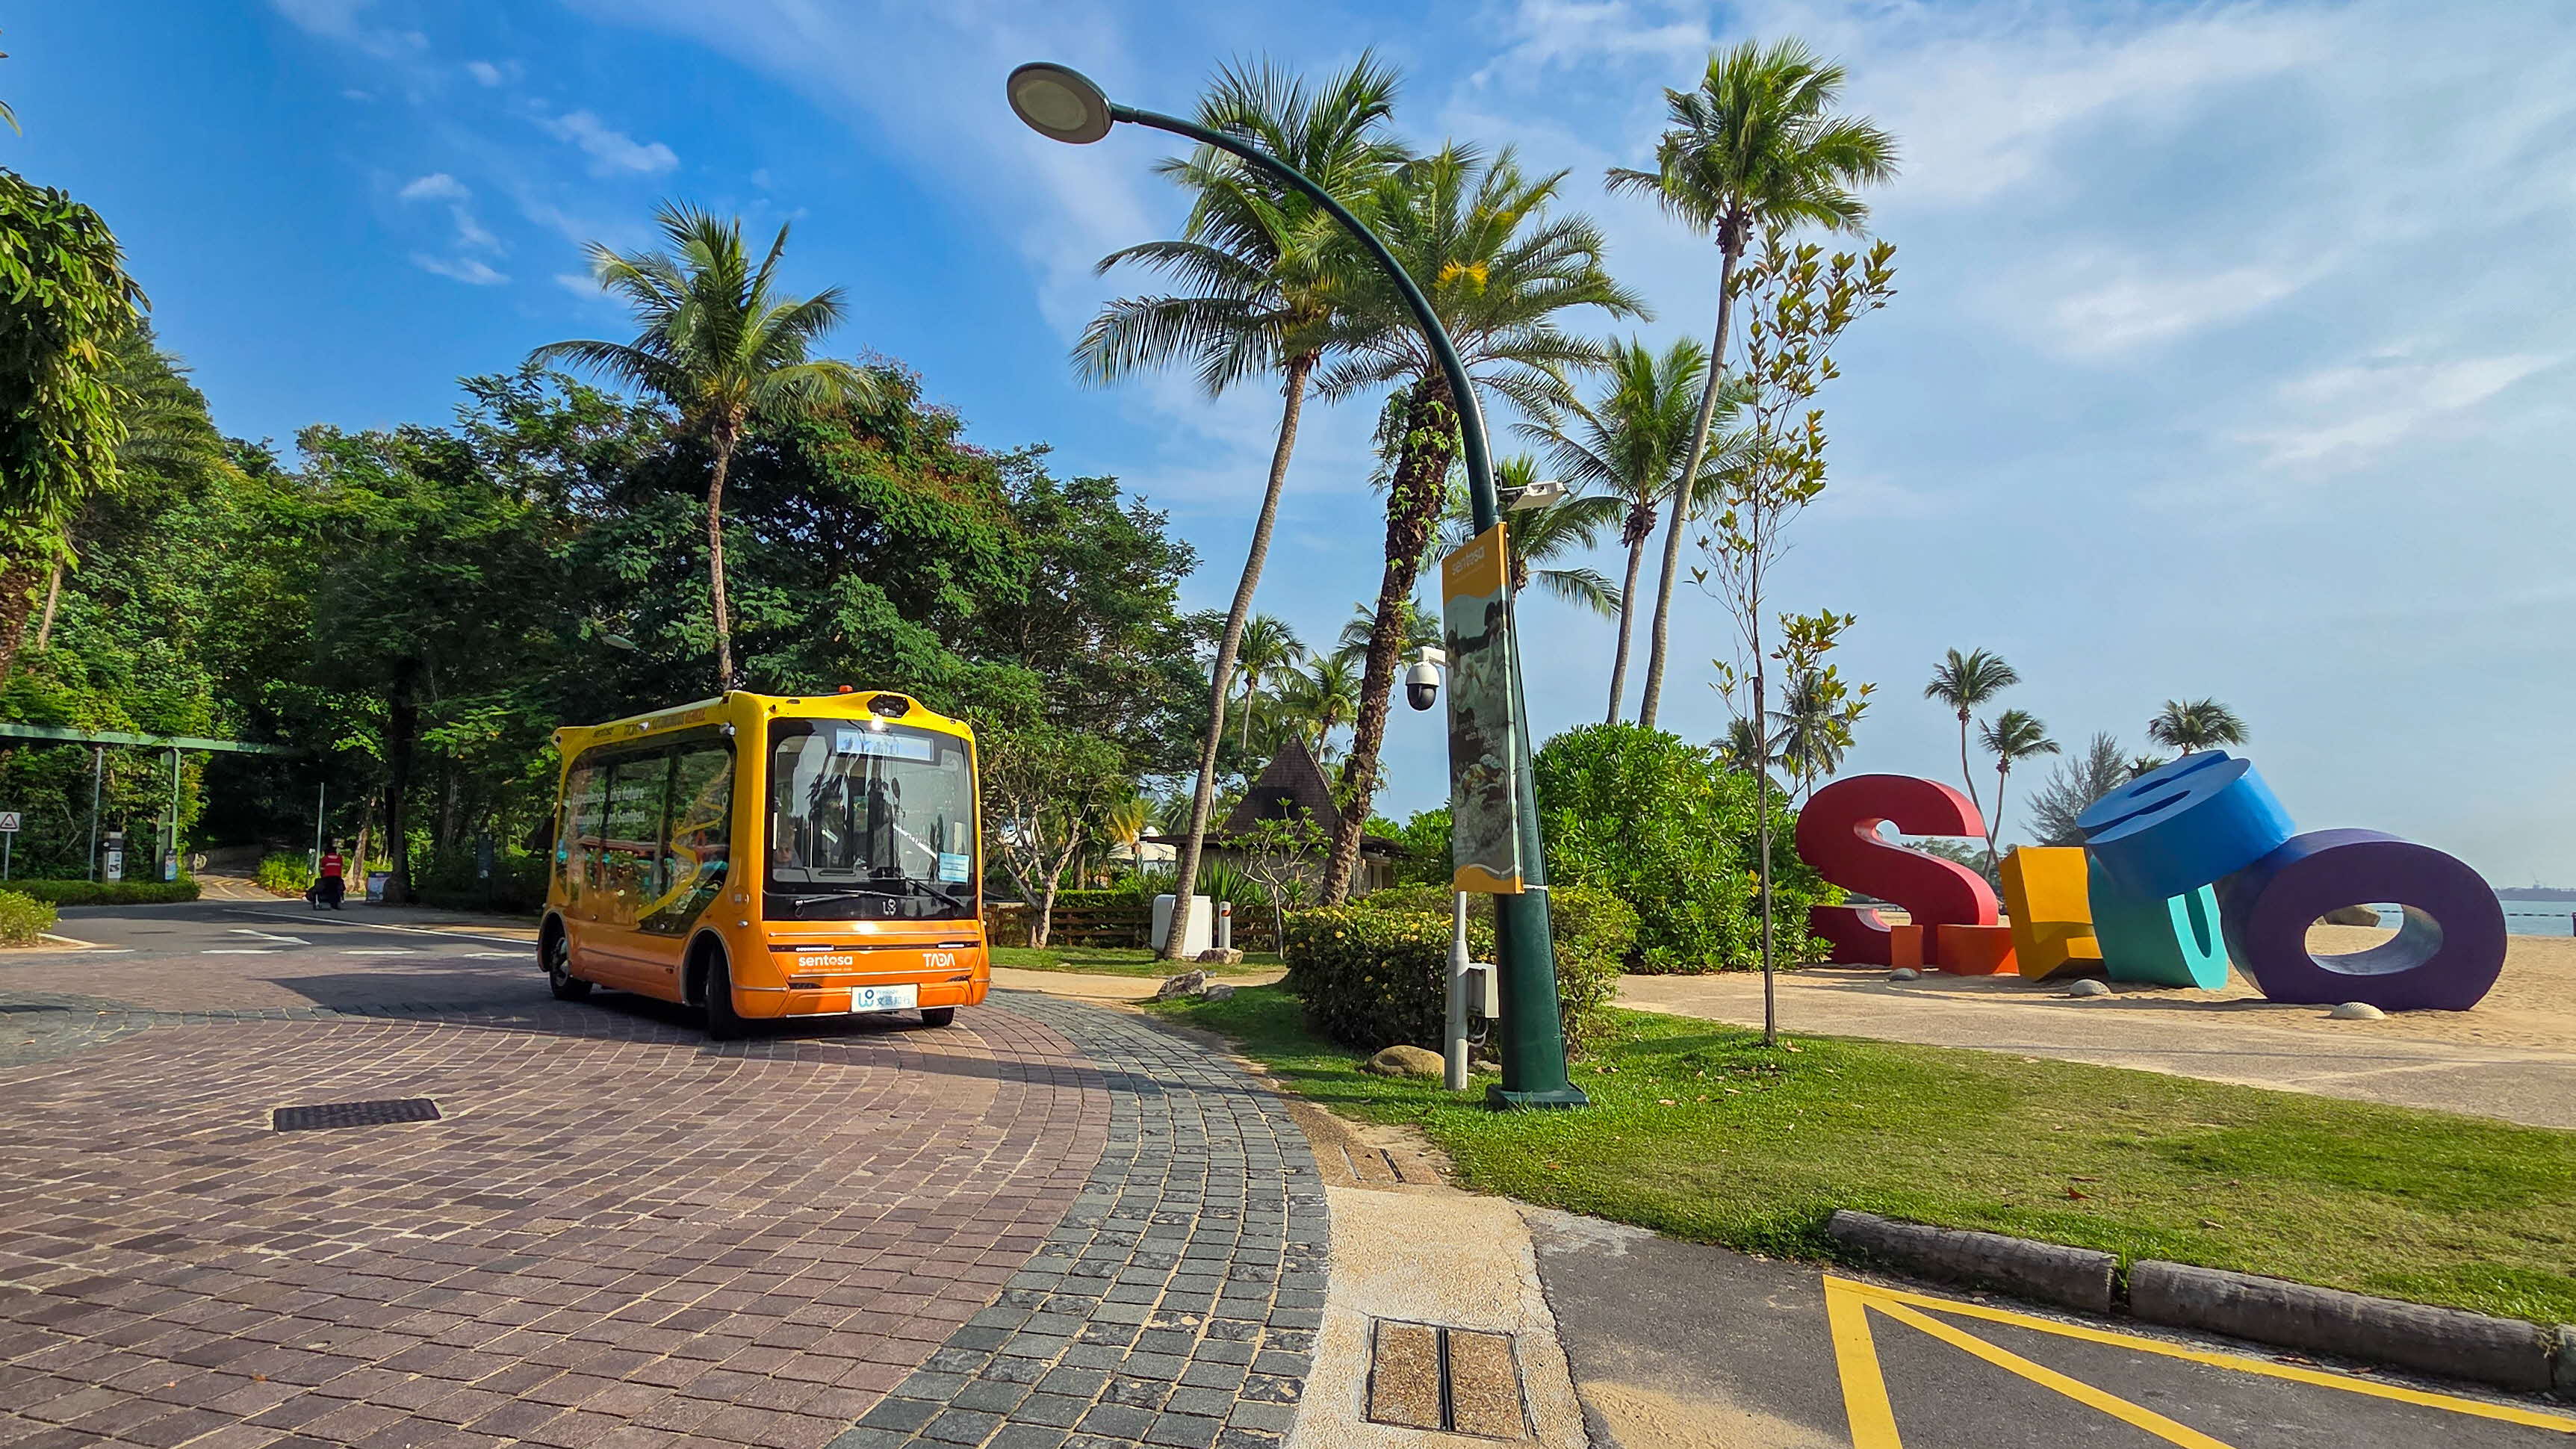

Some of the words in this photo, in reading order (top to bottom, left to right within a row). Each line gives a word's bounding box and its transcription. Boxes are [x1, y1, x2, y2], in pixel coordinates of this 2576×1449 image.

[622, 786, 645, 801] future
[799, 955, 853, 966] sentosa
[922, 952, 955, 967] TADA
